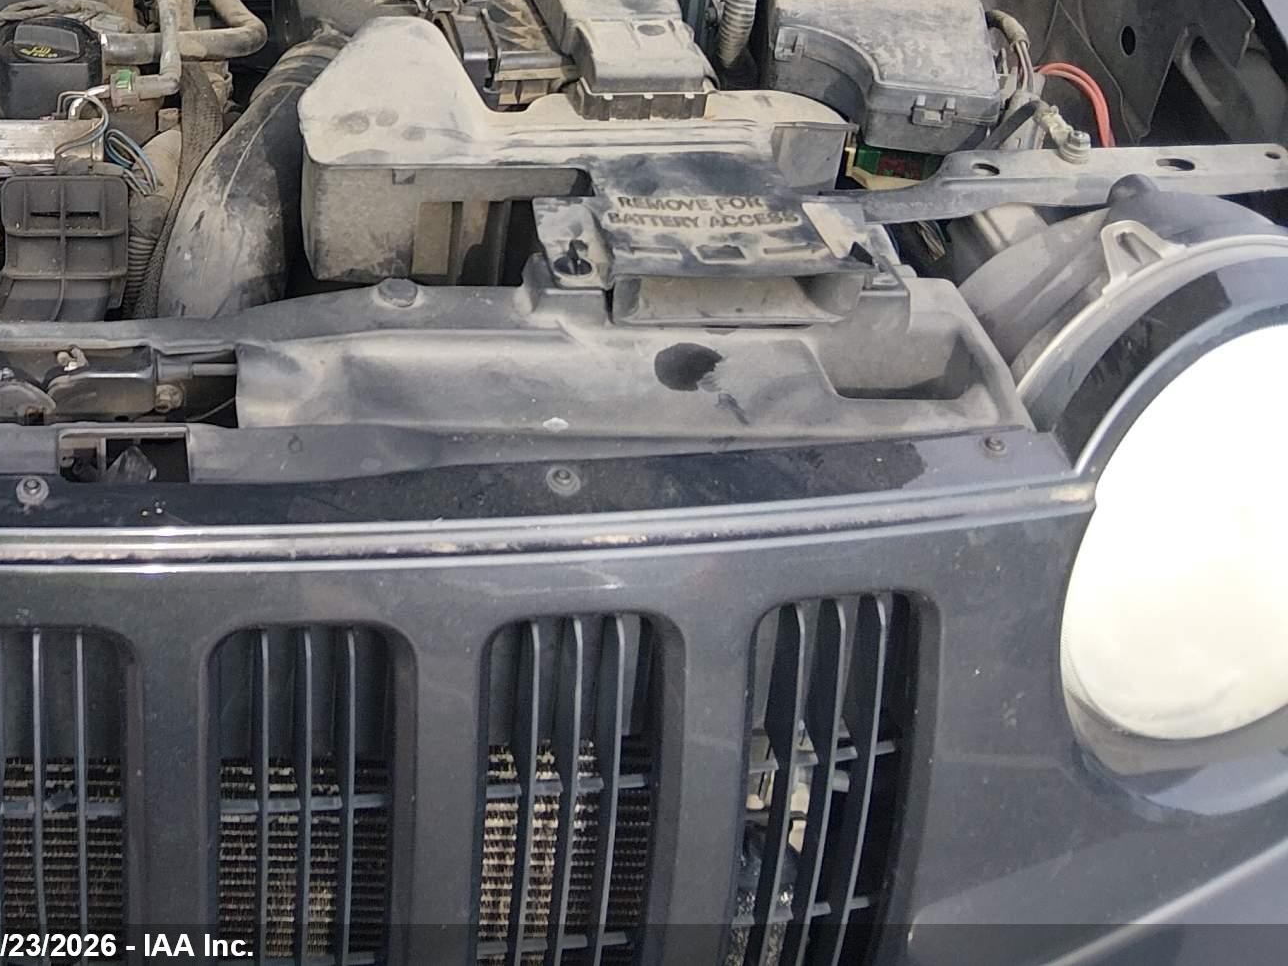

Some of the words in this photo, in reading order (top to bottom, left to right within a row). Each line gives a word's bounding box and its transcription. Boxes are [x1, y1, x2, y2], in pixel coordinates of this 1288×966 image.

[617, 195, 713, 211] REMOVE
[717, 194, 765, 210] FOR
[606, 211, 702, 229] BATTERY
[708, 210, 800, 228] ACCESS
